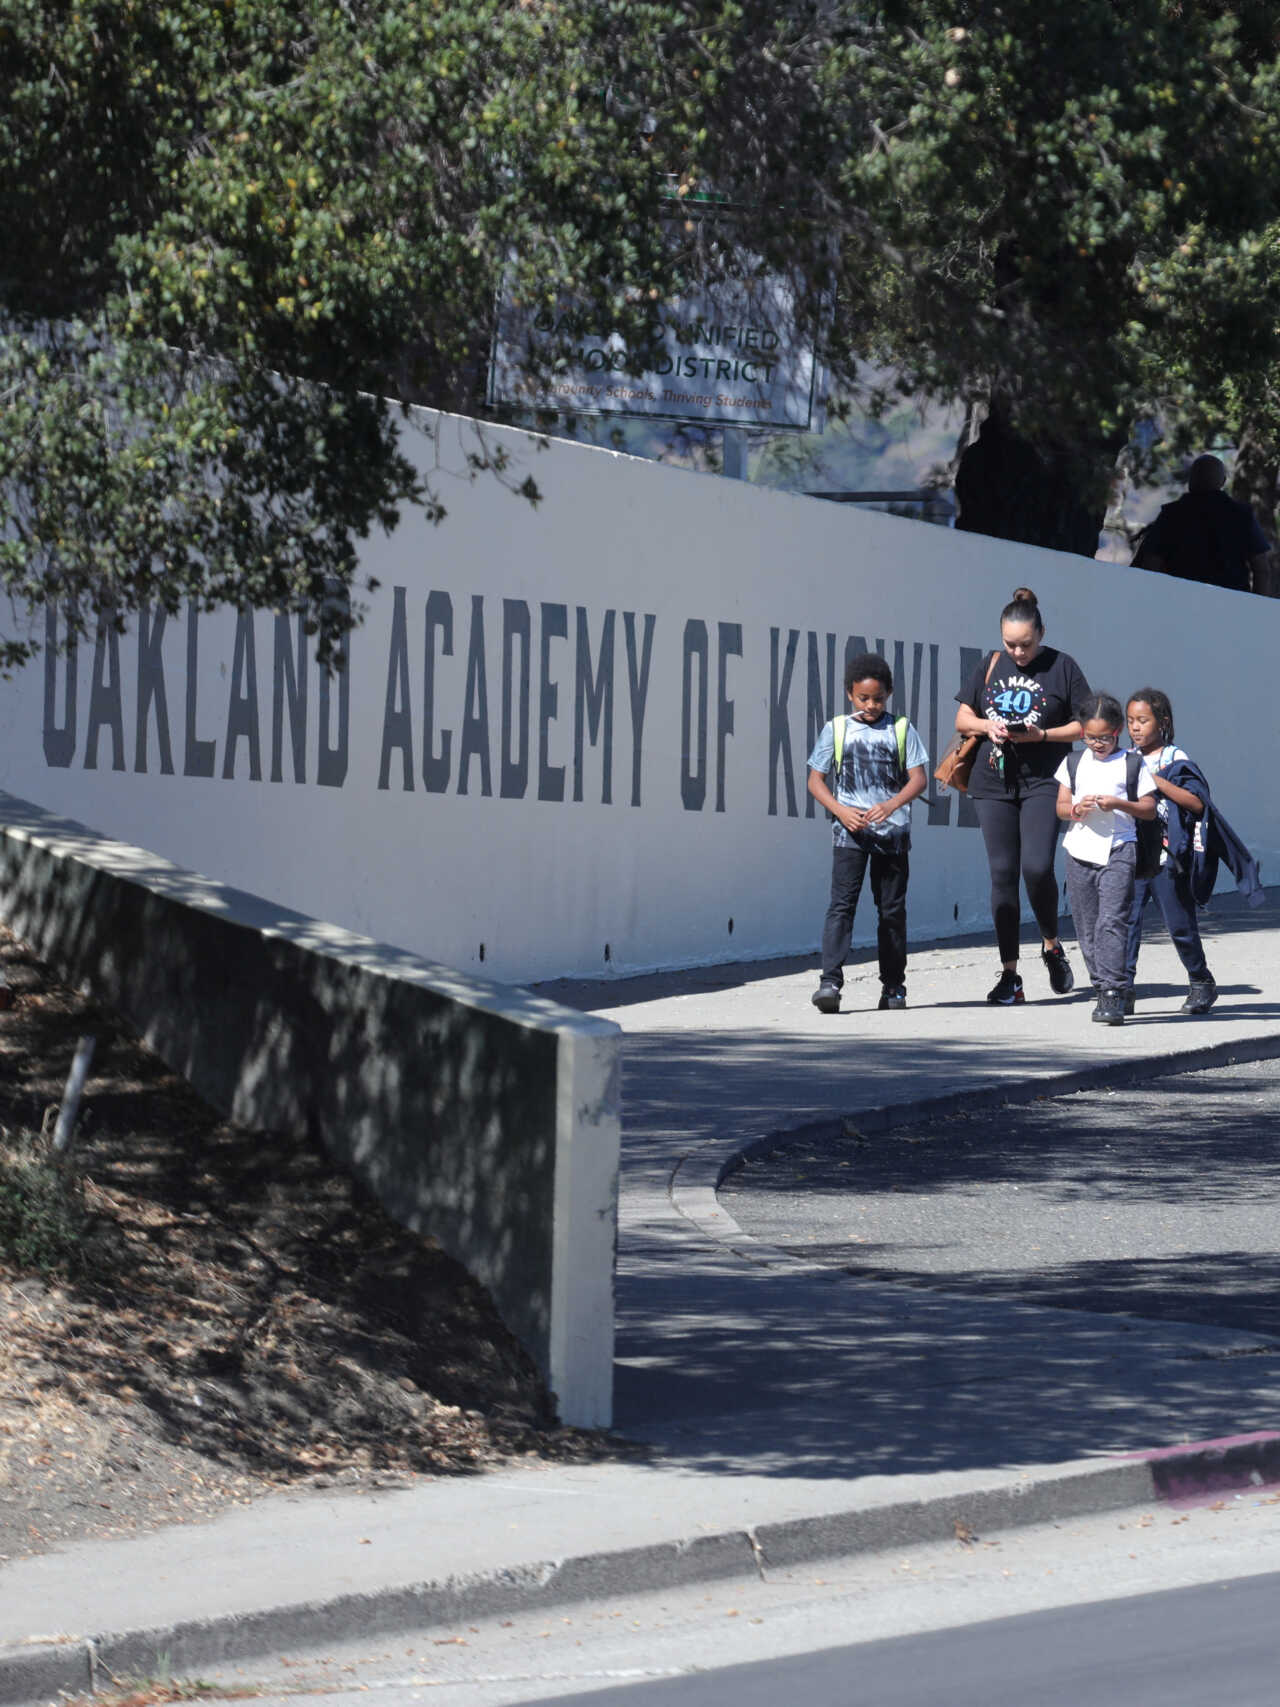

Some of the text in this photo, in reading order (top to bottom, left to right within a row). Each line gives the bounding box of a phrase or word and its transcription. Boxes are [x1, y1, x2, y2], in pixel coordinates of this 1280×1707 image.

[655, 355, 776, 384] DISTRICT
[42, 556, 350, 789] OAKLAND
[377, 585, 657, 808] ACADEMY
[680, 618, 744, 813] OF
[1008, 675, 1041, 692] MAKE
[994, 690, 1031, 714] 40
